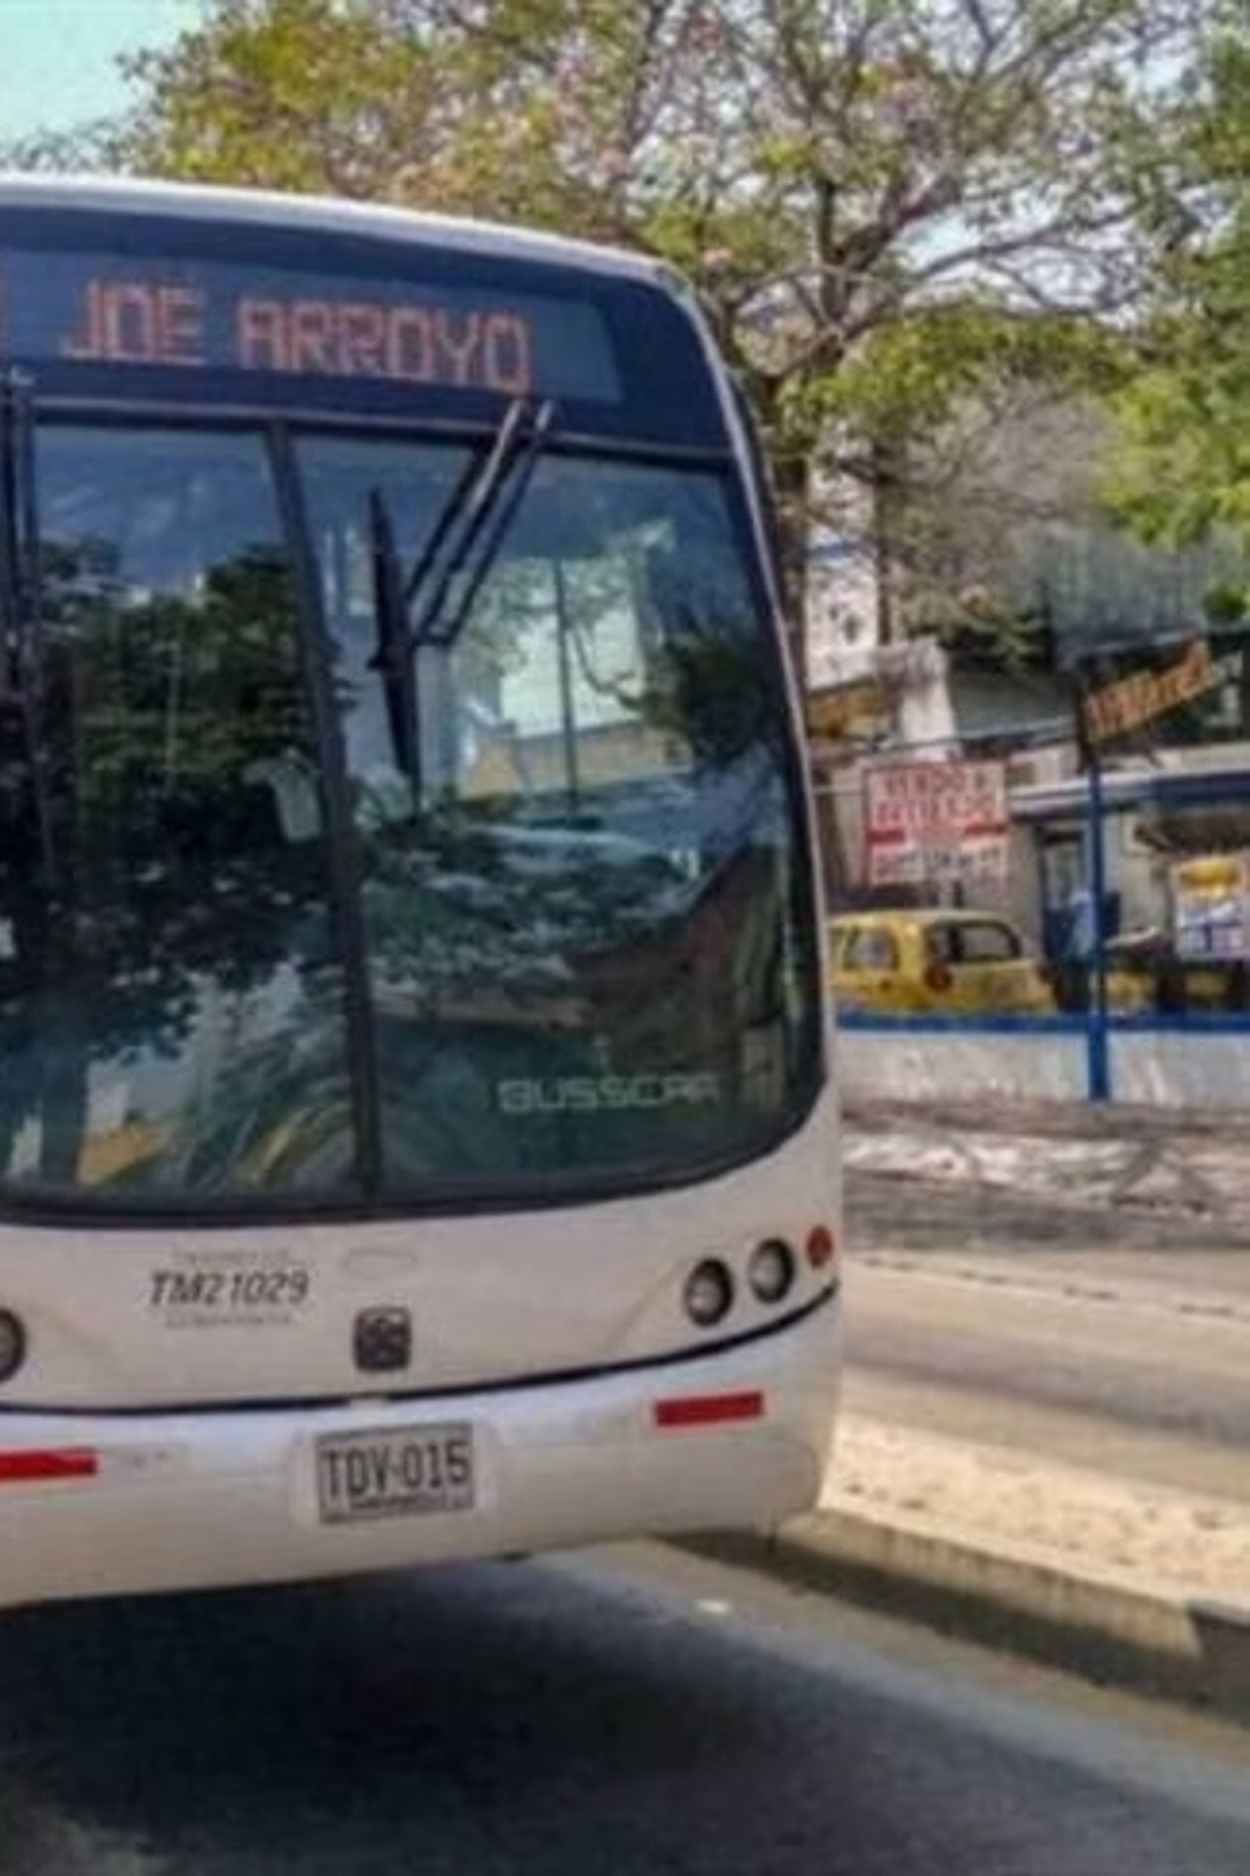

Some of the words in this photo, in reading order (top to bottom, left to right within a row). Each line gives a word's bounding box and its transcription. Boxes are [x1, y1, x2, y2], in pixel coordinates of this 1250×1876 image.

[59, 277, 206, 366] JOE
[238, 297, 533, 393] ARROYO
[498, 1074, 719, 1113] BUSSCAR
[150, 1269, 308, 1305] TM21029
